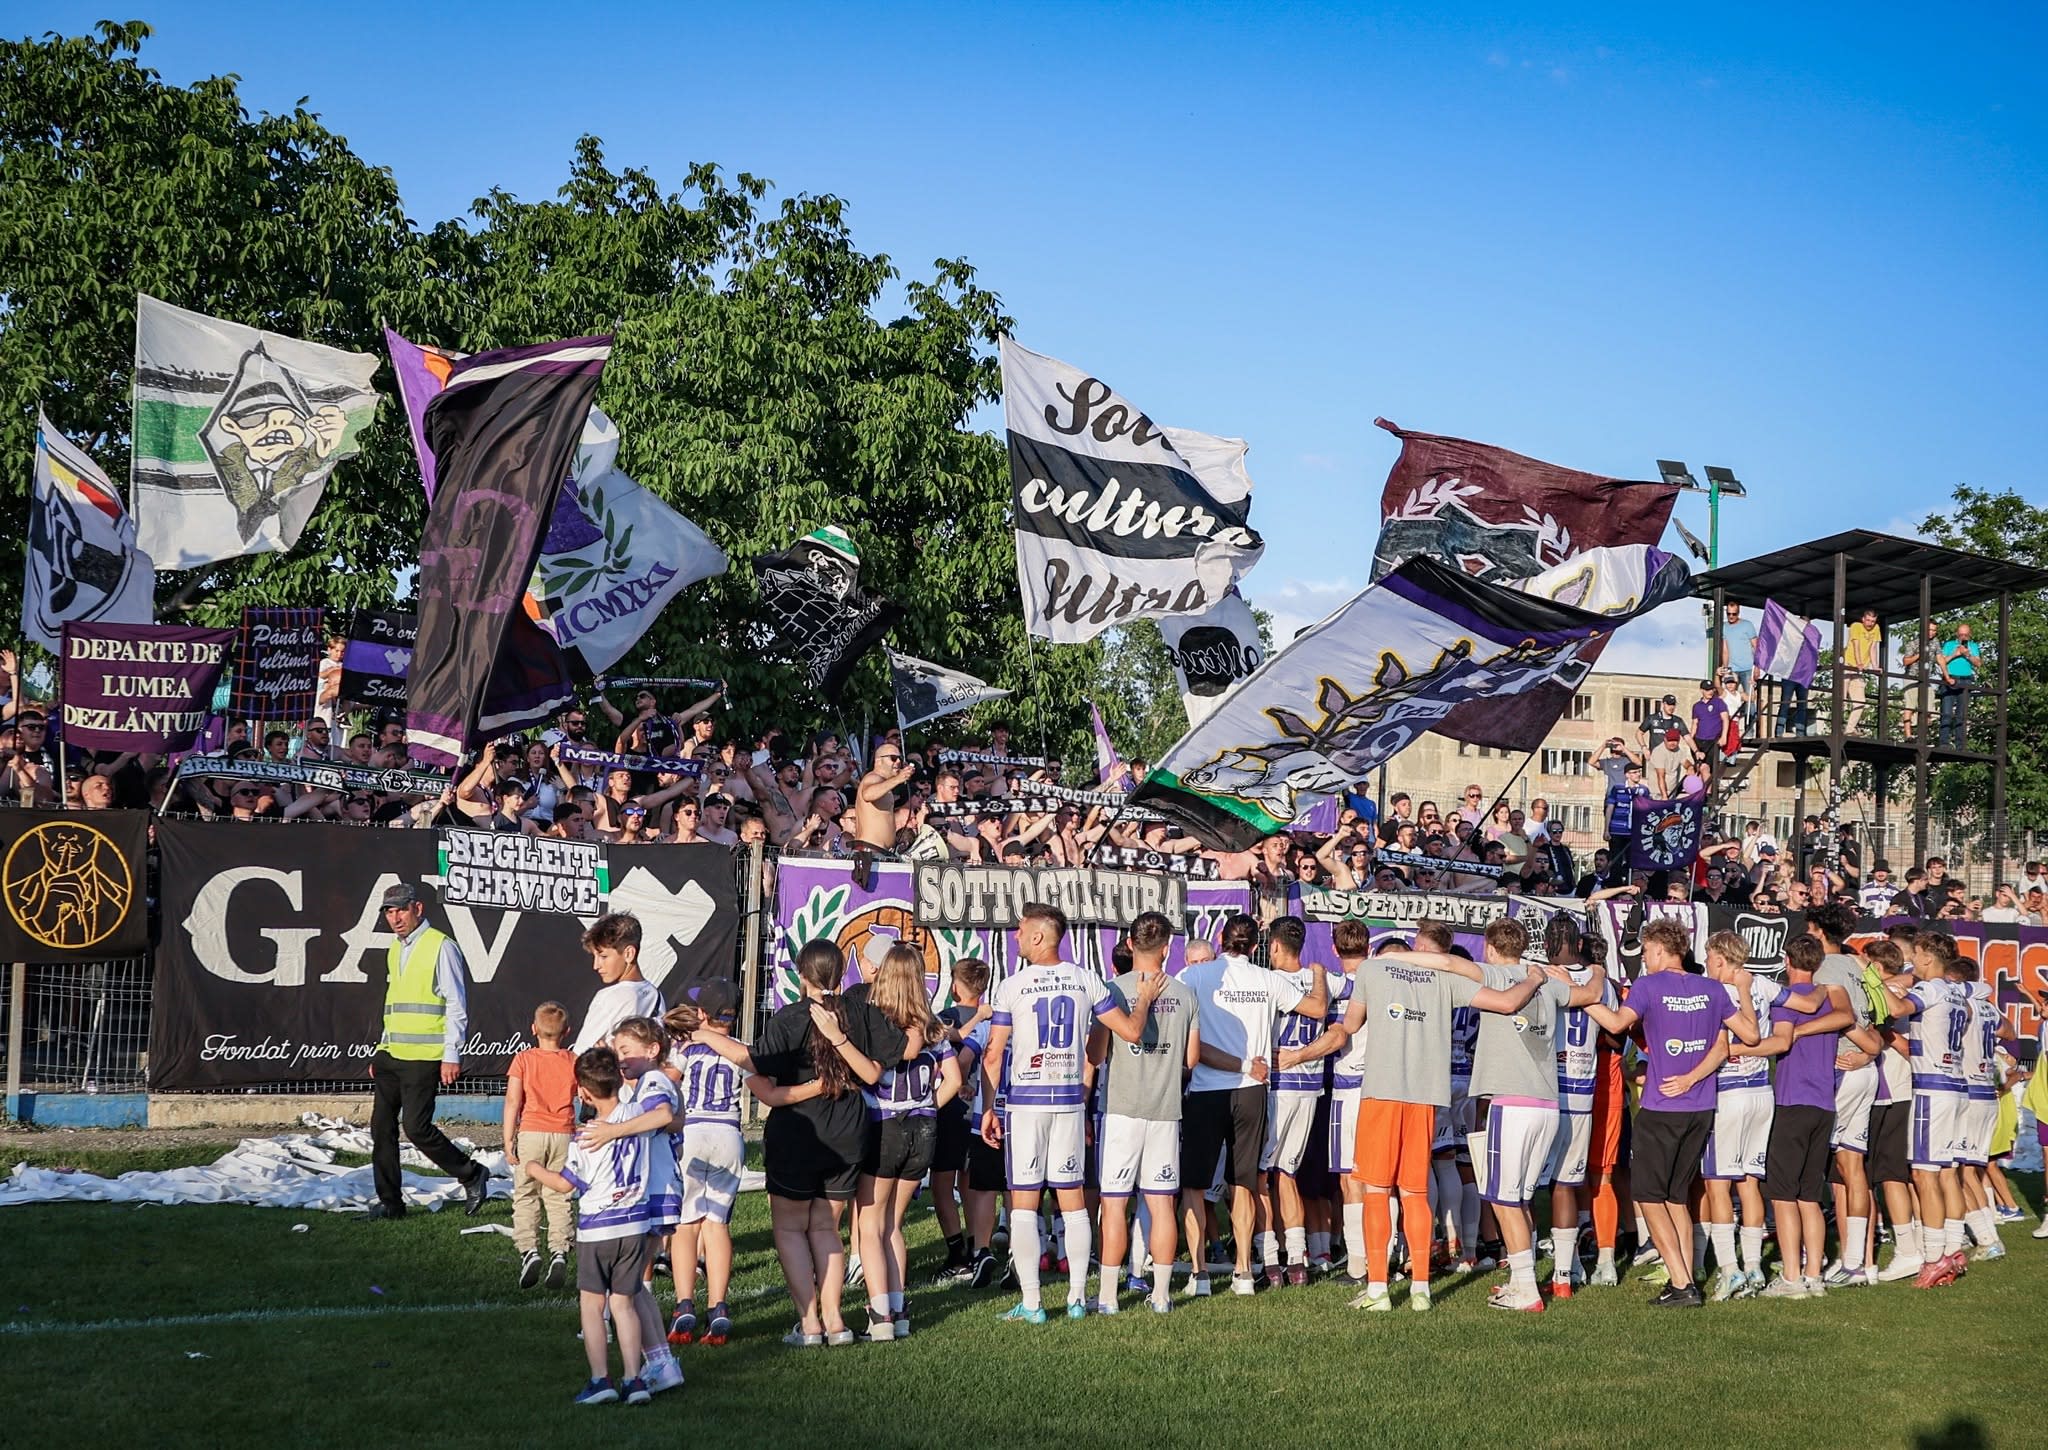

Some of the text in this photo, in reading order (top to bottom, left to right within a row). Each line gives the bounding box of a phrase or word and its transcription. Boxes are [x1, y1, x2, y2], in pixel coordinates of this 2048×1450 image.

[1020, 476, 1252, 546] cultura
[301, 631, 315, 643] la
[371, 618, 418, 640] Pe ori
[70, 637, 223, 665] DEPARTE DE
[259, 652, 310, 670] ultima
[102, 675, 192, 699] LUMEA
[254, 674, 312, 701] suflare
[566, 748, 699, 773] MCM XXI
[448, 829, 599, 880] BEGLEIT
[447, 864, 599, 914] SERVICE
[918, 866, 1184, 931] SOTTOCULTURA
[1020, 985, 1061, 995] CRAMELE
[1031, 994, 1076, 1050] 19
[1948, 1007, 1968, 1052] 18
[200, 1033, 290, 1061] Fondat
[289, 1043, 342, 1068] prin
[347, 1043, 377, 1058] voi
[685, 1060, 733, 1112] 10
